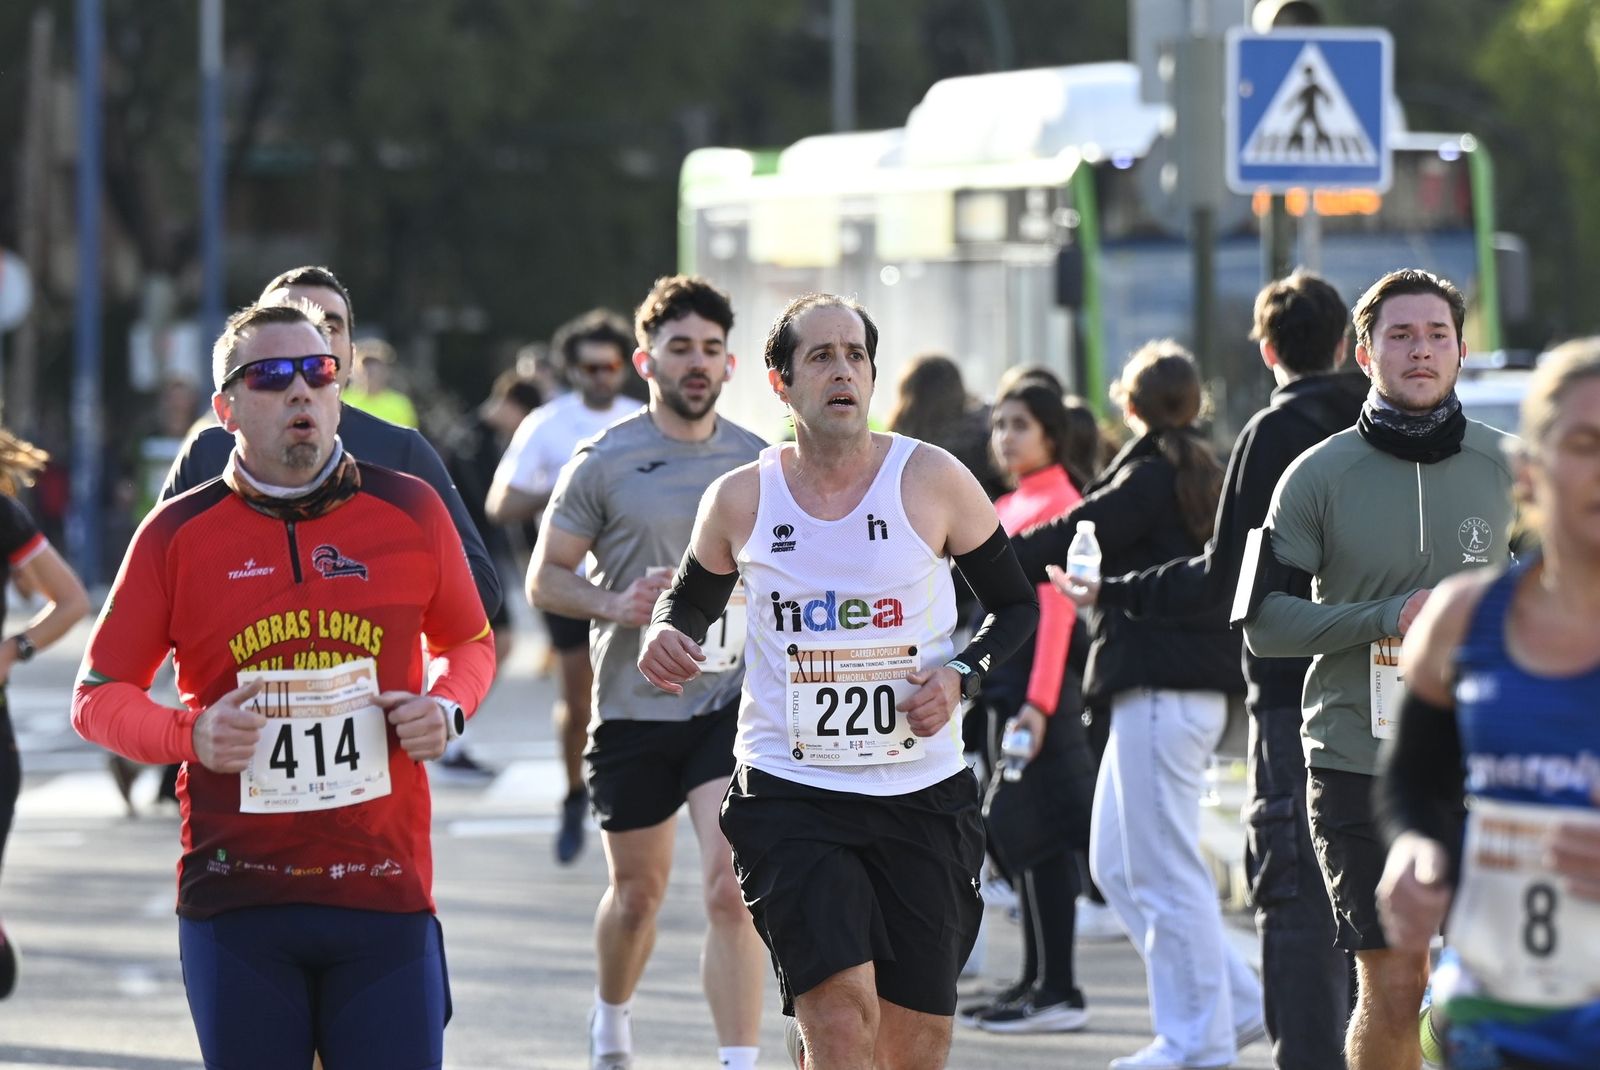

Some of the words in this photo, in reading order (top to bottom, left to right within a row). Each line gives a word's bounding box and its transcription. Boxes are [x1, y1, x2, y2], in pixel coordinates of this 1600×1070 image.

[867, 513, 888, 540] in
[1461, 519, 1489, 535] ITALICA
[770, 590, 904, 632] indea
[229, 609, 311, 665] KABRAS
[318, 609, 384, 657] LOKAS
[850, 649, 876, 658] CARRERA
[876, 647, 900, 657] POPULAR
[794, 650, 836, 683] XLII
[836, 673, 867, 681] MEMORIAL
[816, 685, 896, 736] 220
[269, 717, 360, 779] 414
[1523, 881, 1558, 958] 8
